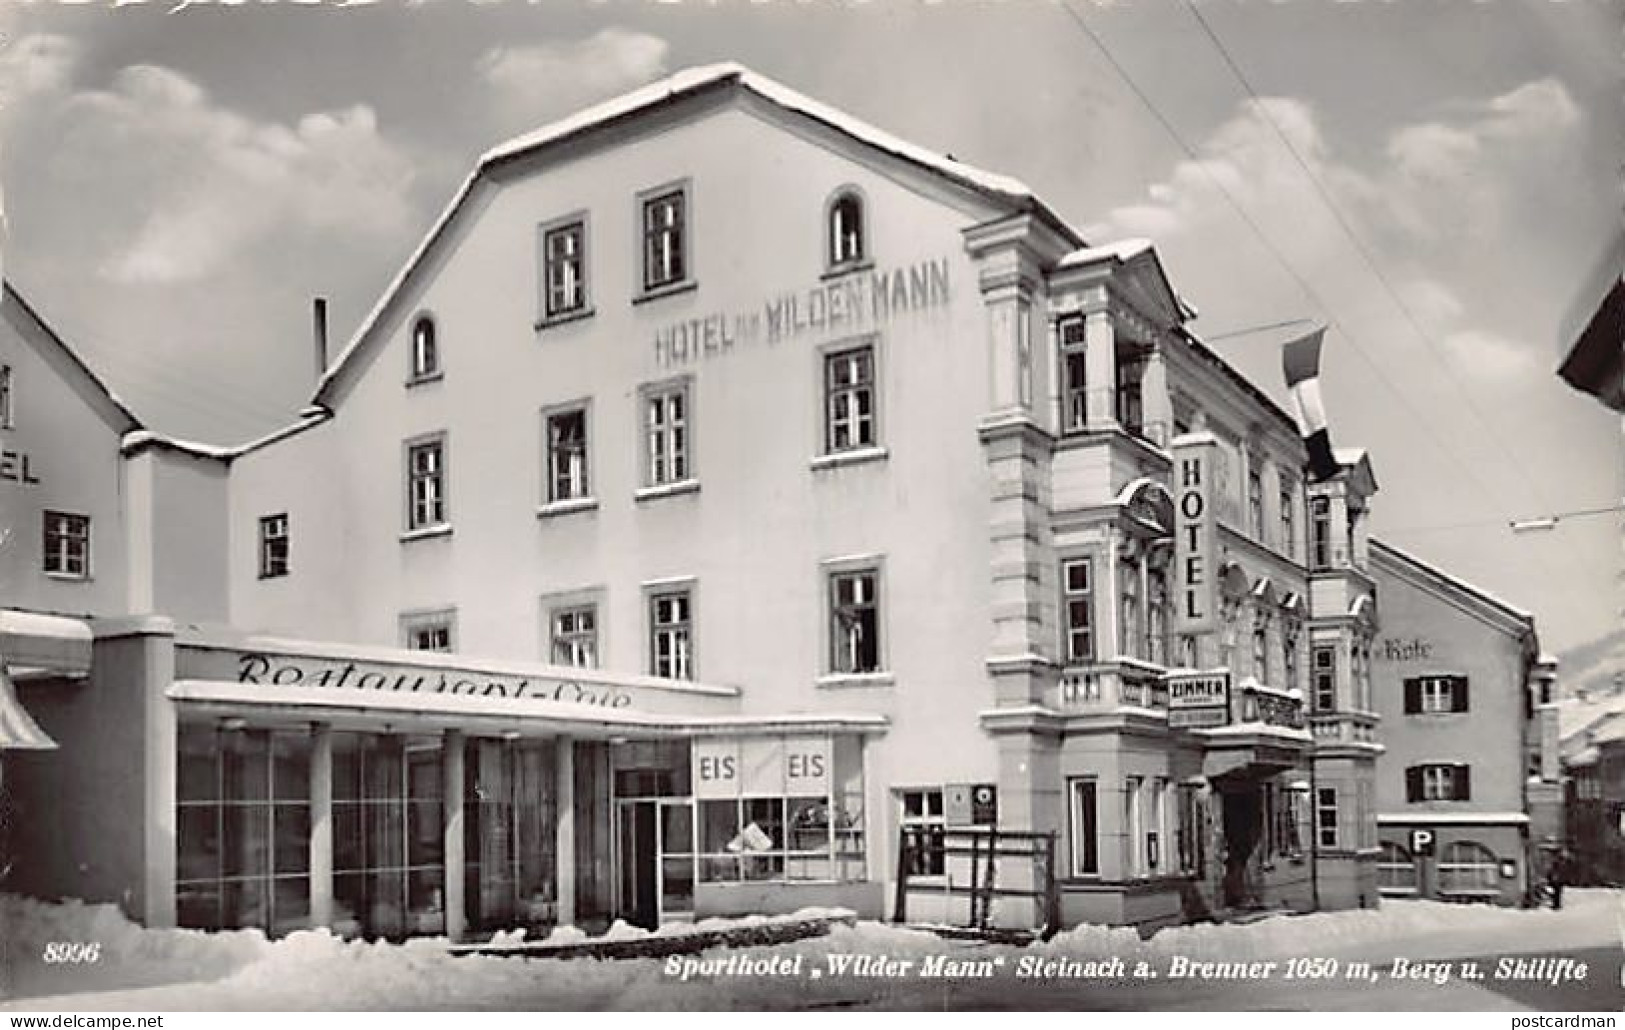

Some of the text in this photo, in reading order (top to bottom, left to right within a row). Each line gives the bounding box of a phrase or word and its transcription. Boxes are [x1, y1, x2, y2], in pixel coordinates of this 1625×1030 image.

[656, 309, 734, 368] HOTEL
[764, 276, 864, 344] WILDEN
[870, 257, 951, 323] MANN
[1181, 458, 1204, 619] HOTEL
[1171, 680, 1224, 697] ZIMMER
[700, 757, 736, 781] EIS
[788, 754, 825, 778] EIS
[1412, 831, 1433, 853] P
